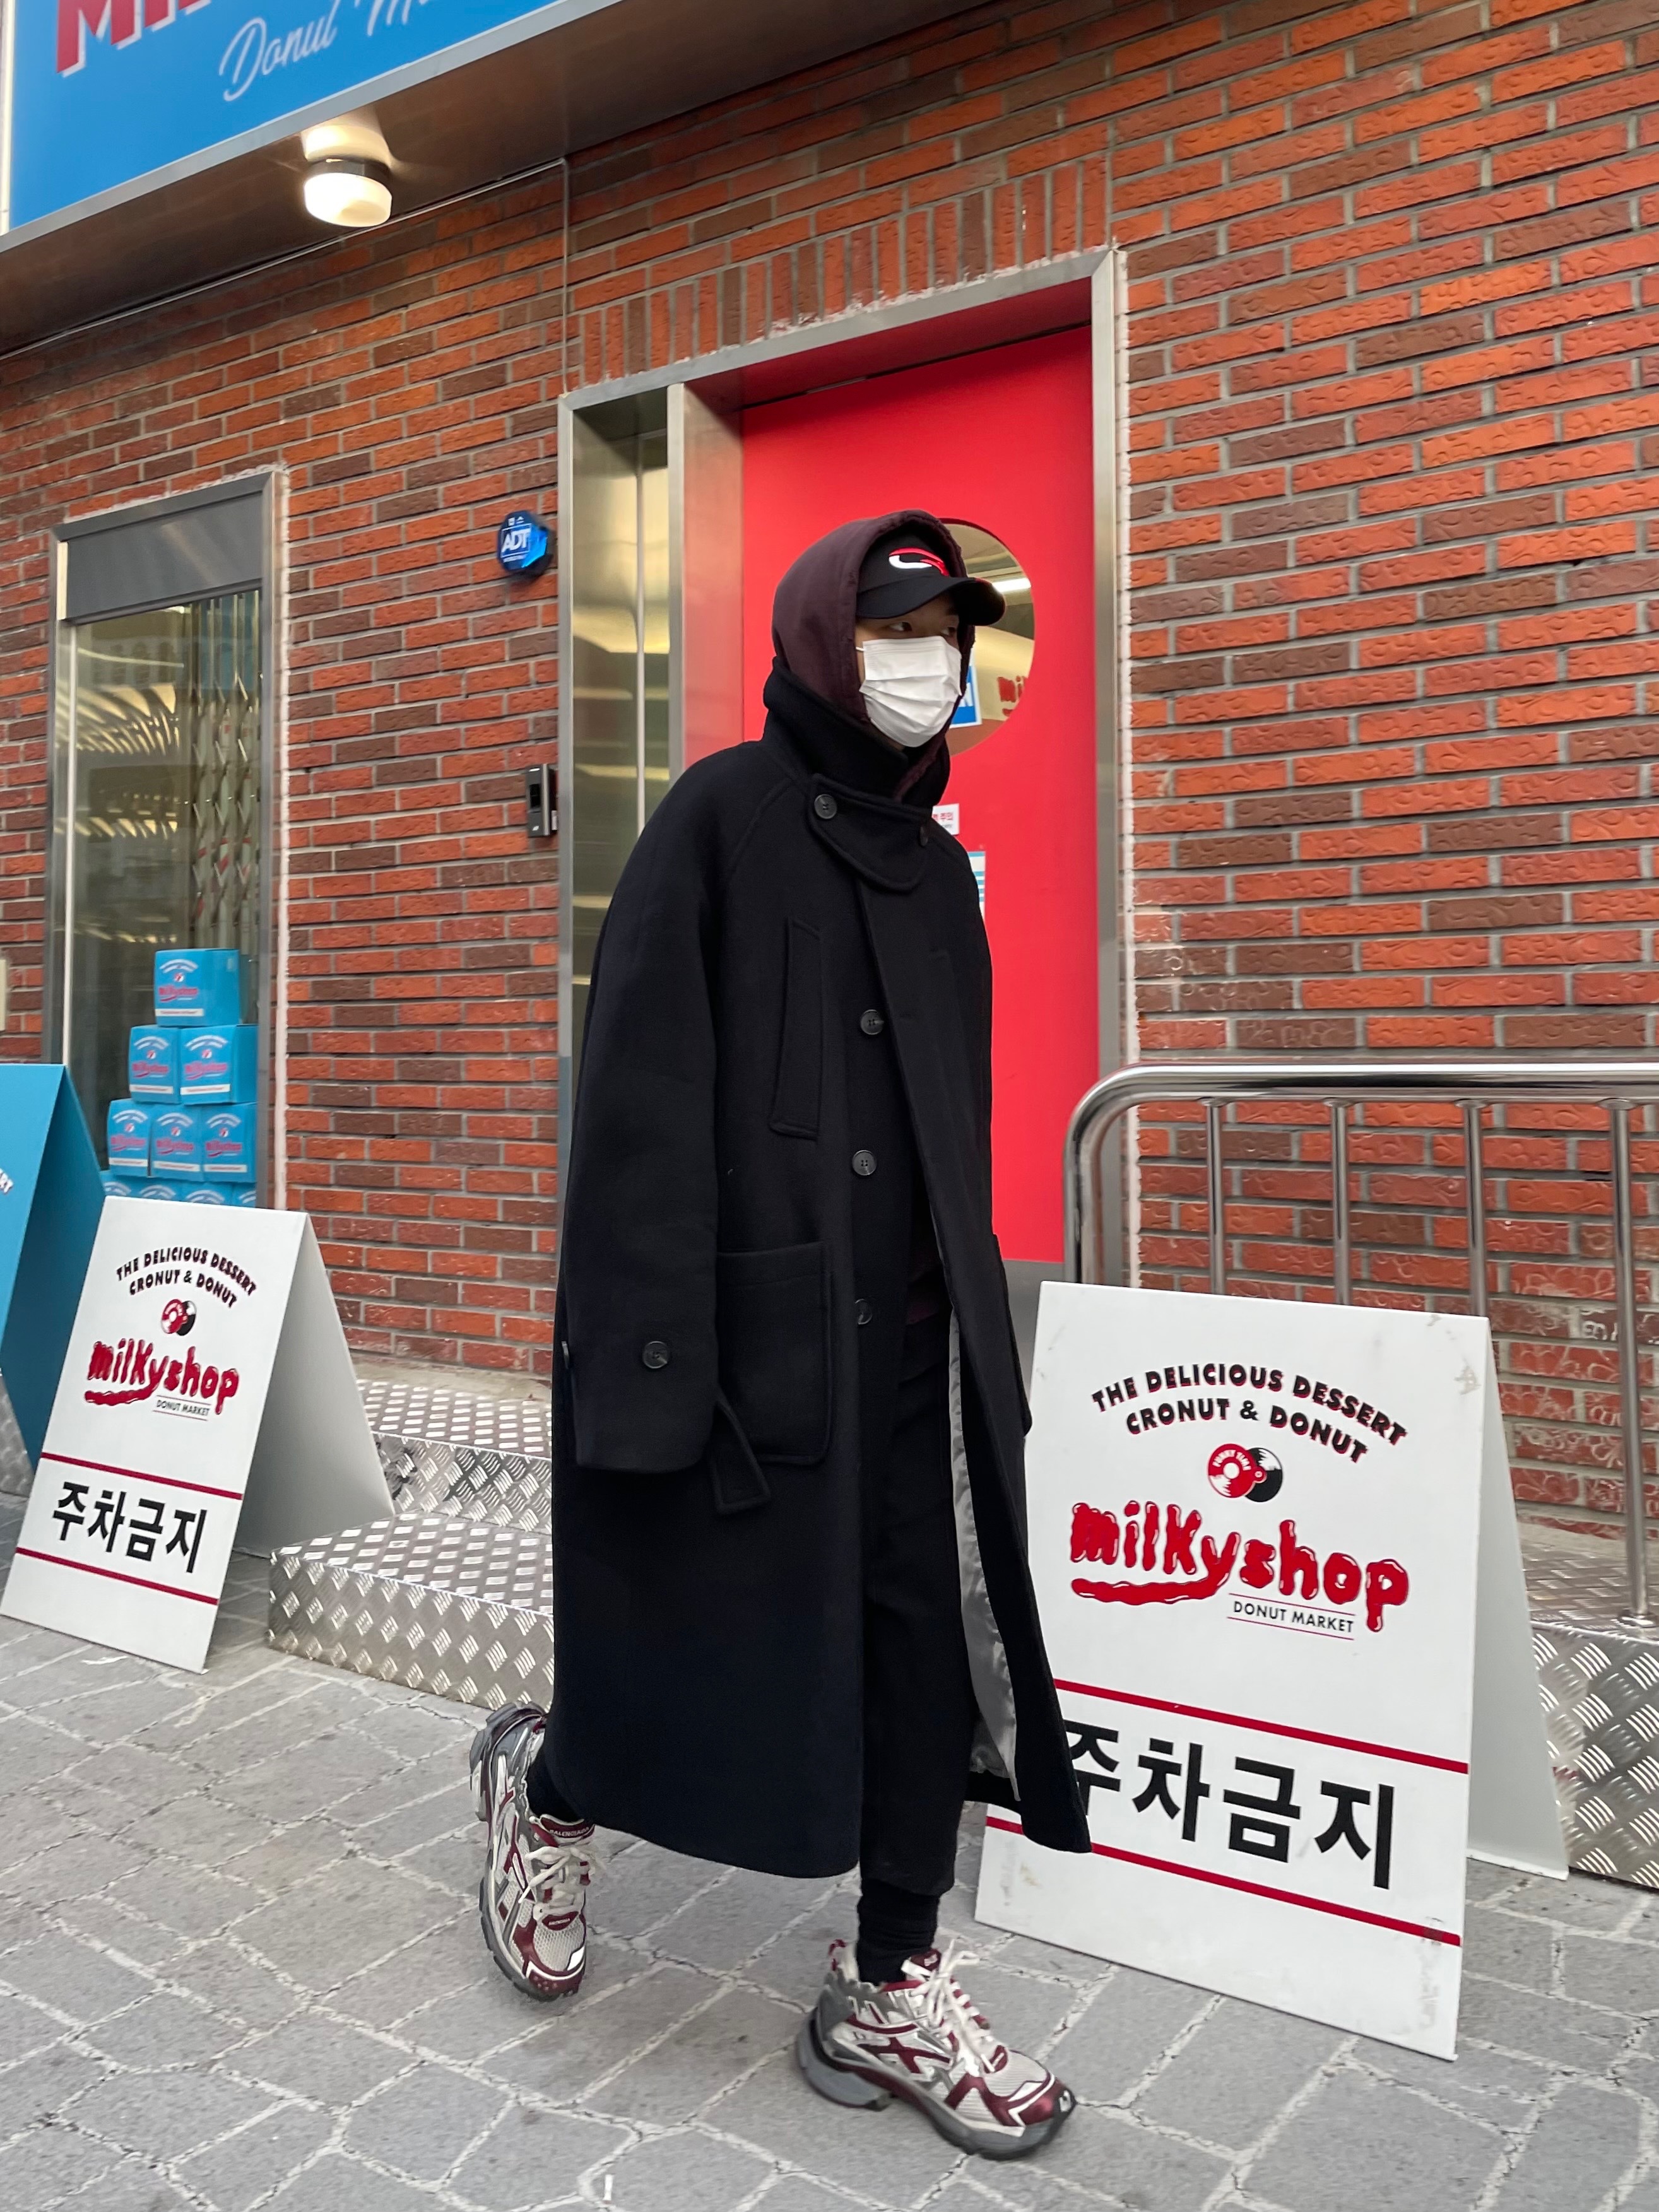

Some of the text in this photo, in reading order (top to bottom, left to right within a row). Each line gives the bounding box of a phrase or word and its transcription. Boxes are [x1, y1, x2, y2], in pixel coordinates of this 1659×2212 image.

[501, 528, 531, 553] ADT
[116, 1247, 256, 1296] THE DELICIOUS DESSERT
[129, 1269, 237, 1308] CRONUT & DONUT
[156, 1399, 210, 1416] DONUT MARKET
[1091, 1363, 1408, 1445] THE DELICIOUS DESSERT
[1126, 1398, 1368, 1464] CRONUT & DONUT
[52, 1481, 207, 1574] 주차금지
[1234, 1601, 1354, 1633] DONUT MARKET
[1065, 1719, 1395, 1890] 주차금지
